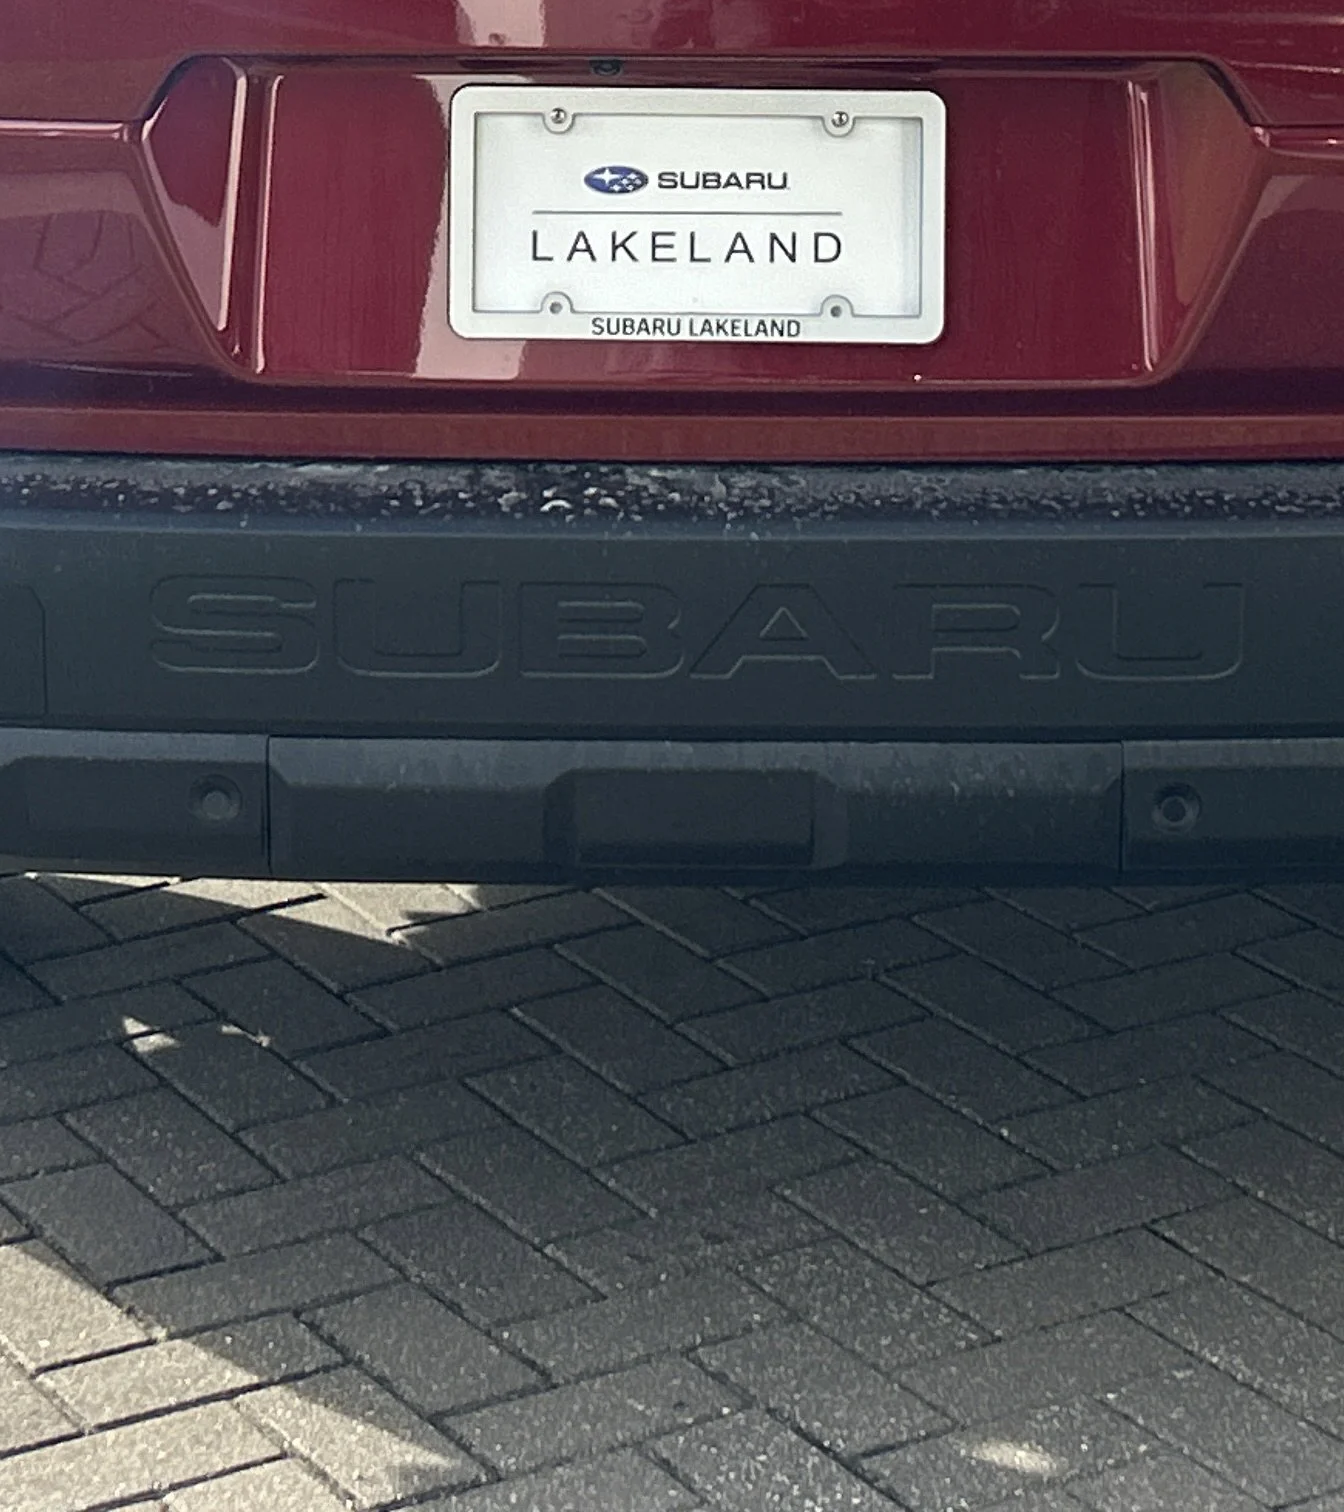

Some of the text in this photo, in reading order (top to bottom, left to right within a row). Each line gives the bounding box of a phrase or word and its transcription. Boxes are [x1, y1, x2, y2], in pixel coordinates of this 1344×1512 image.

[657, 170, 791, 190] SUBARU
[531, 229, 843, 264] LAKELAND
[590, 316, 802, 339] SUBARU LAKELAND
[149, 573, 1245, 681] SUBARU
